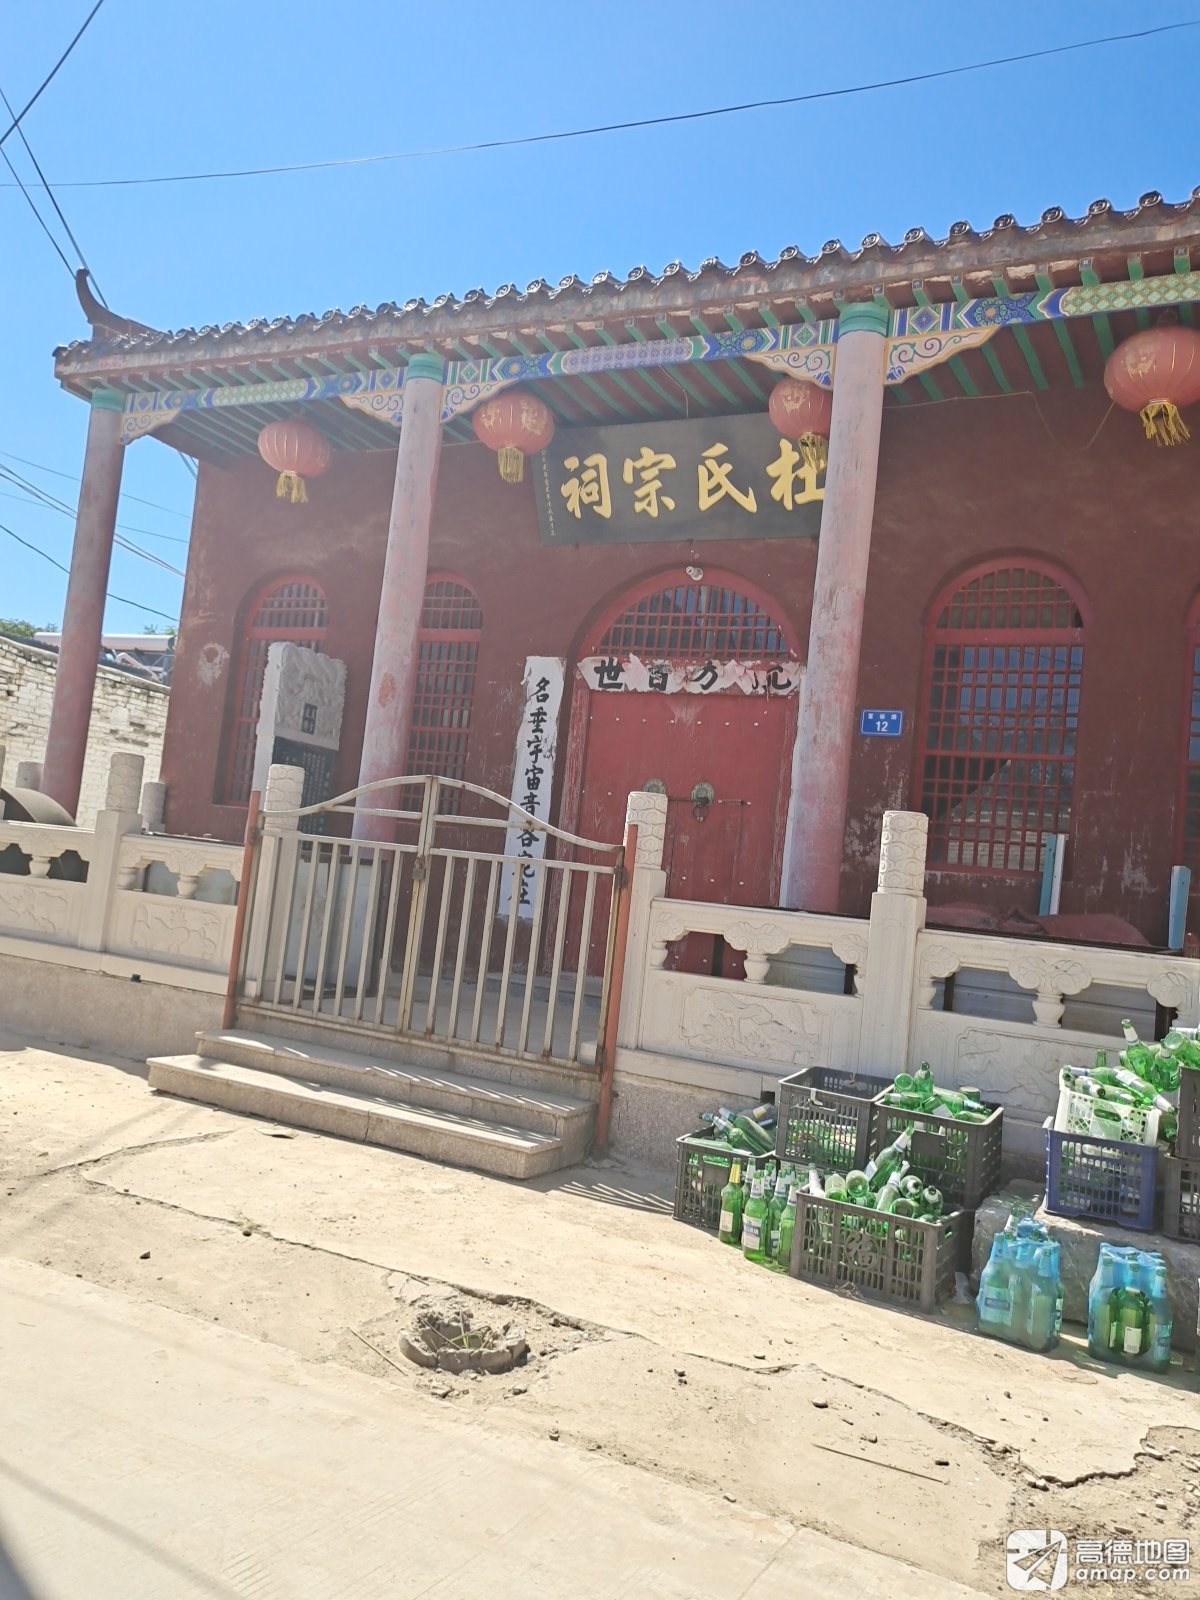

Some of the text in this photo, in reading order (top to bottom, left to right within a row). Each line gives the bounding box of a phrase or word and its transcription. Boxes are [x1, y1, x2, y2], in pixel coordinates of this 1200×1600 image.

[561, 438, 827, 518] 杜氏宗祠
[876, 721, 888, 732] 12
